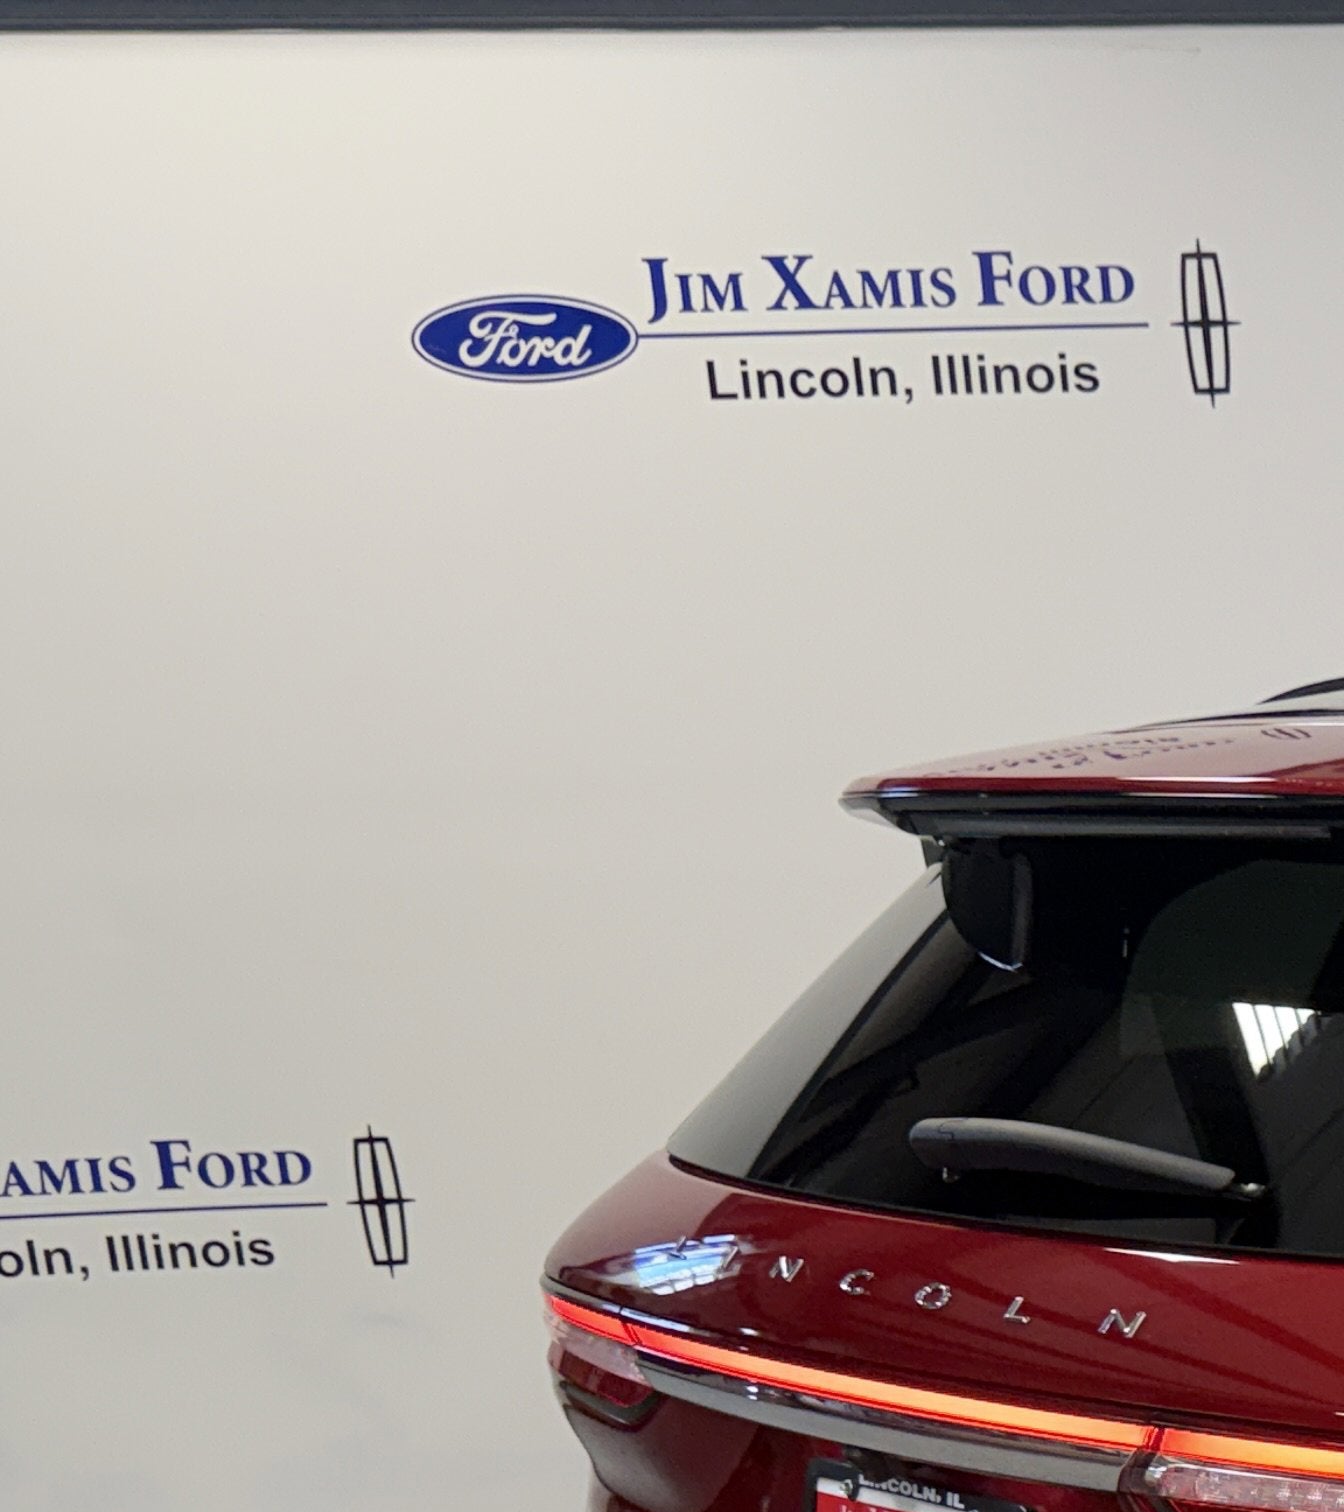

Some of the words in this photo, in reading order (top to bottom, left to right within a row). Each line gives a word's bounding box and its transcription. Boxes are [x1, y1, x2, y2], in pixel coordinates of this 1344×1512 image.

[642, 257, 746, 323] JIM
[761, 253, 957, 312] XAMIS
[972, 250, 1135, 306] FORD
[457, 309, 593, 368] Ford
[706, 356, 913, 404] Lincoln,
[931, 352, 1100, 395] Illinois
[0, 1156, 136, 1198] AMIS
[150, 1139, 312, 1191] FORD
[105, 1230, 275, 1272] Illinois
[859, 1475, 942, 1502] LCOLN,
